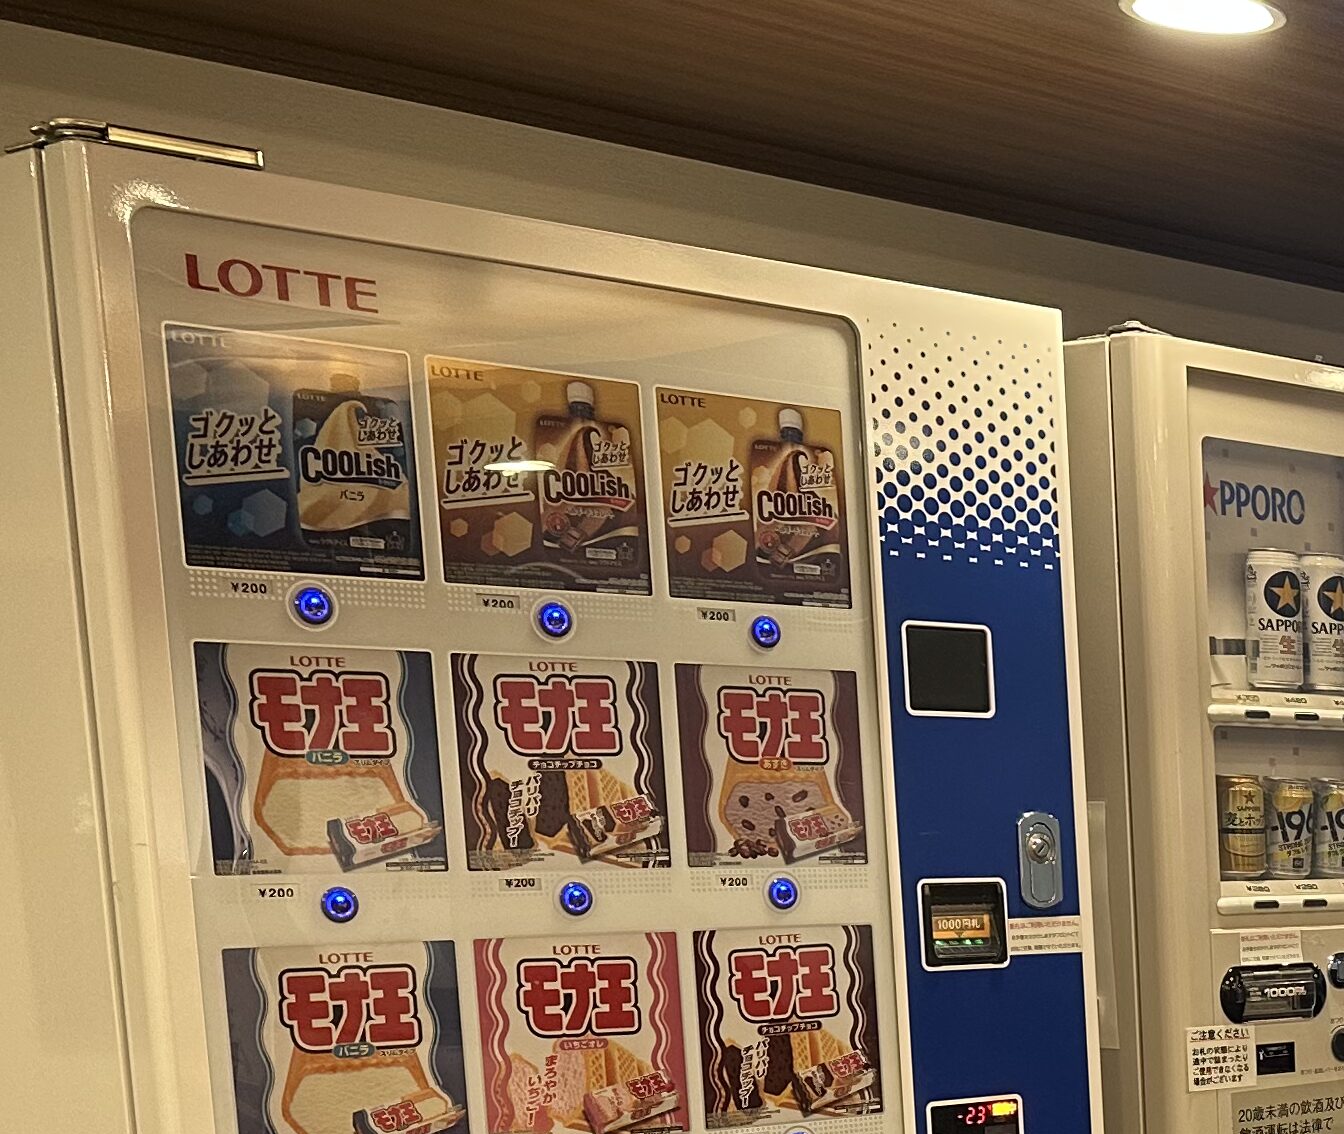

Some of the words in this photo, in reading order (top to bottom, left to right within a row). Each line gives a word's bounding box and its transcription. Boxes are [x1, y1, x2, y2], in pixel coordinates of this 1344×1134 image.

[185, 253, 378, 313] LOTTE
[431, 365, 484, 382] LOTTE
[660, 393, 706, 408] LOTTE
[190, 407, 280, 439] ゴクッと
[187, 441, 277, 469] しあわせ
[447, 436, 522, 466] ゴクッと
[673, 459, 739, 486] ゴクッと
[672, 486, 738, 513] しあわせ
[1204, 476, 1305, 525] PPORO
[231, 582, 267, 594] ¥200
[483, 599, 514, 609] ¥200
[701, 611, 729, 621] ¥200
[1258, 618, 1300, 632] SAPPO
[290, 655, 346, 667] LOTTE
[529, 661, 578, 673] LOTTE
[749, 675, 792, 686] LOTTE
[250, 669, 396, 757] モナ王
[495, 675, 622, 756] モナ王
[718, 687, 828, 764] モナ王
[311, 752, 342, 763] バニラ
[345, 812, 398, 843] モナ王
[504, 878, 535, 888] ¥200
[720, 877, 748, 886] ¥200
[258, 888, 294, 898] ¥200
[759, 934, 801, 945] LOTTE
[319, 952, 374, 964] LOTTE
[553, 945, 600, 956] LOTTE
[728, 945, 839, 1022] モナ王
[518, 957, 641, 1037] モナ王
[280, 965, 421, 1052] モナ王
[1191, 1028, 1249, 1040] ご注意ください
[339, 1046, 369, 1056] バニラ
[543, 1055, 558, 1104] まろやか
[627, 1072, 667, 1099] モナ王
[372, 1100, 422, 1133] モナ王
